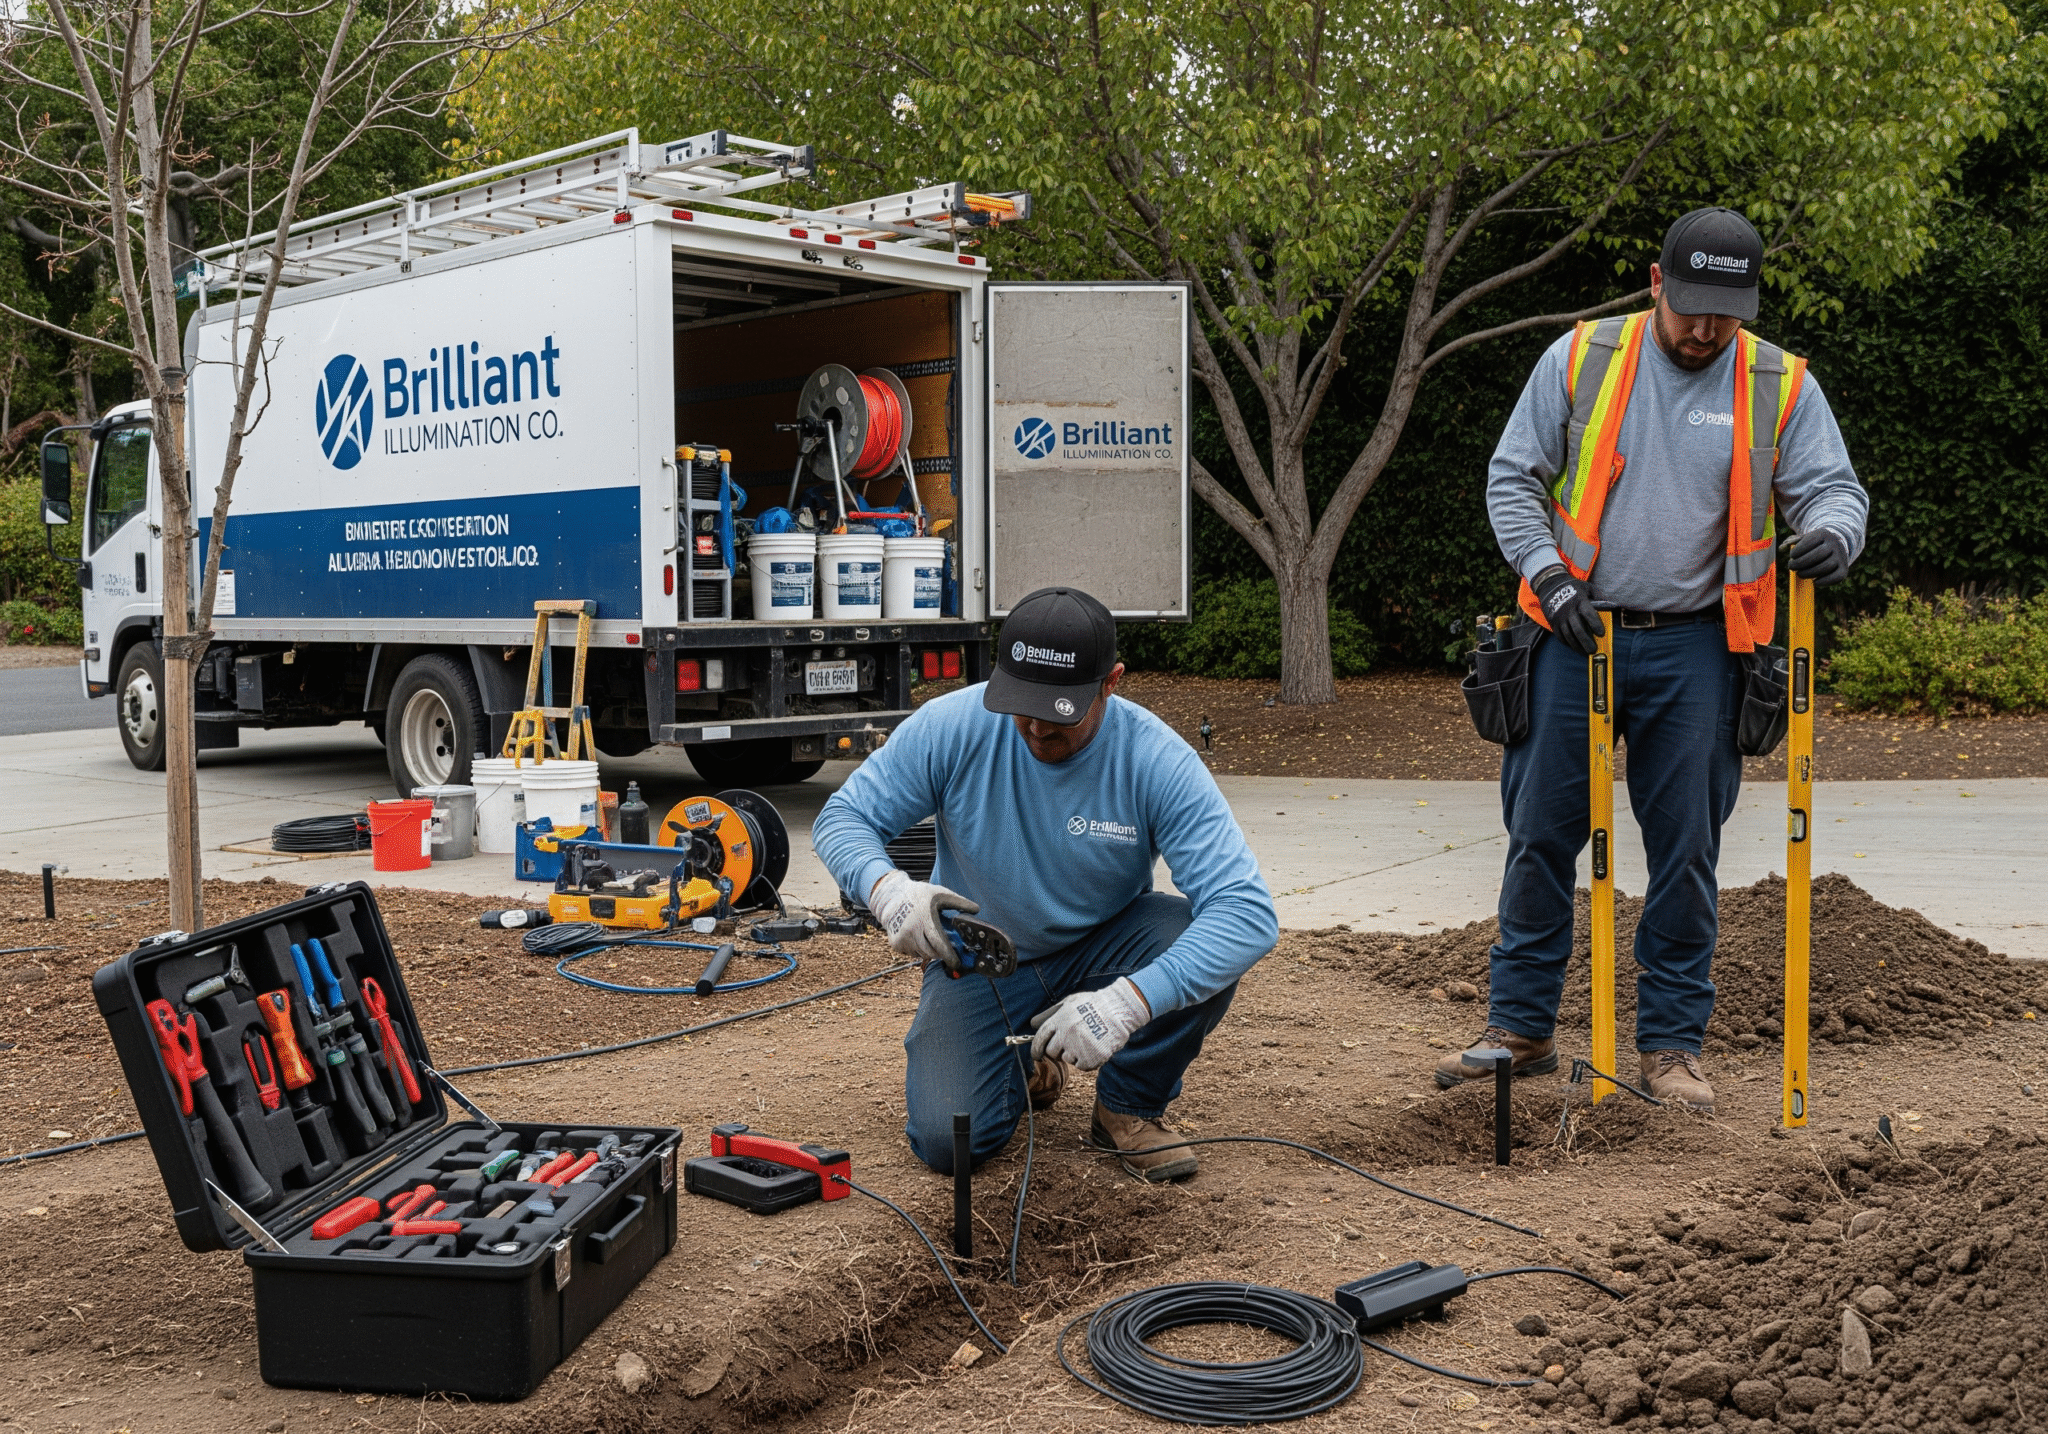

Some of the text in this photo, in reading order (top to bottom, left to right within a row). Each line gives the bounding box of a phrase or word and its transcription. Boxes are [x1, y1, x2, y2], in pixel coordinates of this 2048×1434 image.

[383, 335, 561, 419] Brilliant
[384, 409, 564, 455] ILLUMINATION CO.
[1063, 421, 1172, 445] Brilliant
[1154, 449, 1174, 460] CO.
